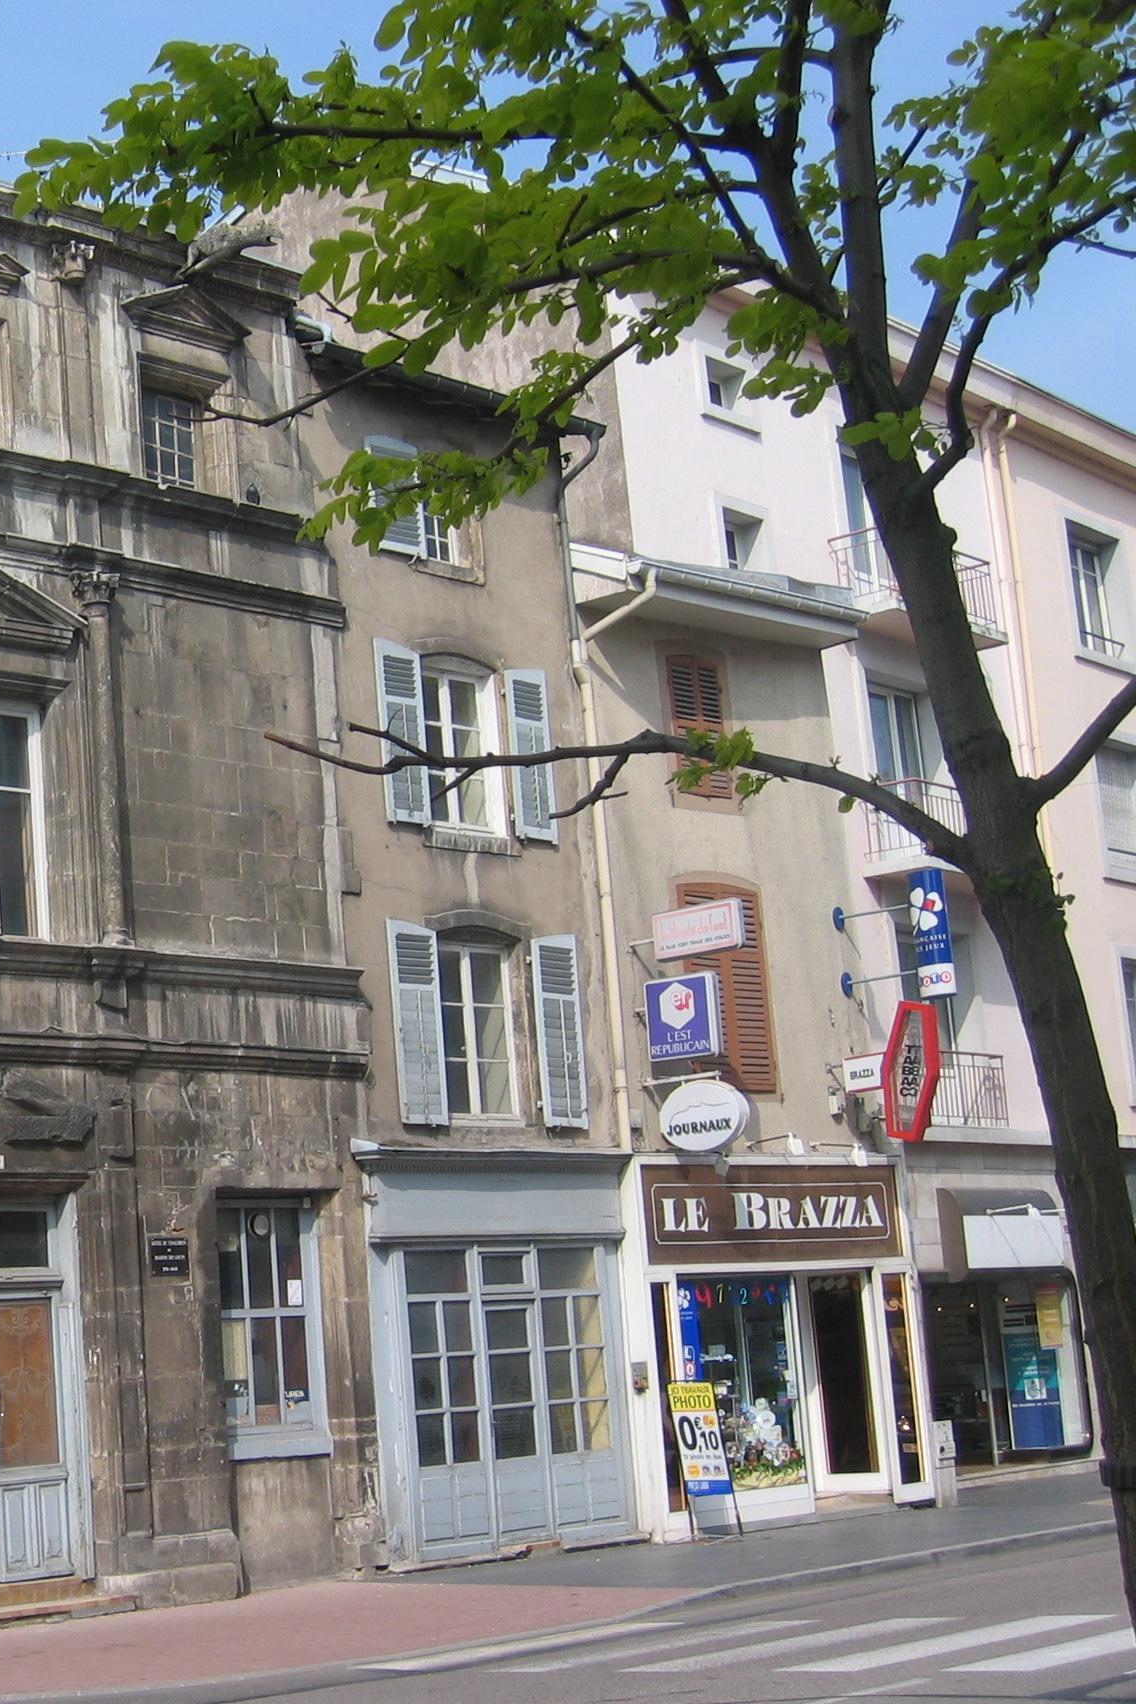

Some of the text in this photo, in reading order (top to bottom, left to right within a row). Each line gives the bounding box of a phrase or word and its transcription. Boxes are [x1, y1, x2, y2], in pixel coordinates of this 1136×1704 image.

[667, 1029, 692, 1042] L'EST
[849, 1068, 874, 1080] BRAZZA
[667, 1117, 732, 1137] JOURNAUX
[660, 1192, 884, 1233] LE BRAZZA
[681, 1385, 710, 1395] TRAVAUX
[672, 1395, 712, 1409] PHOTO
